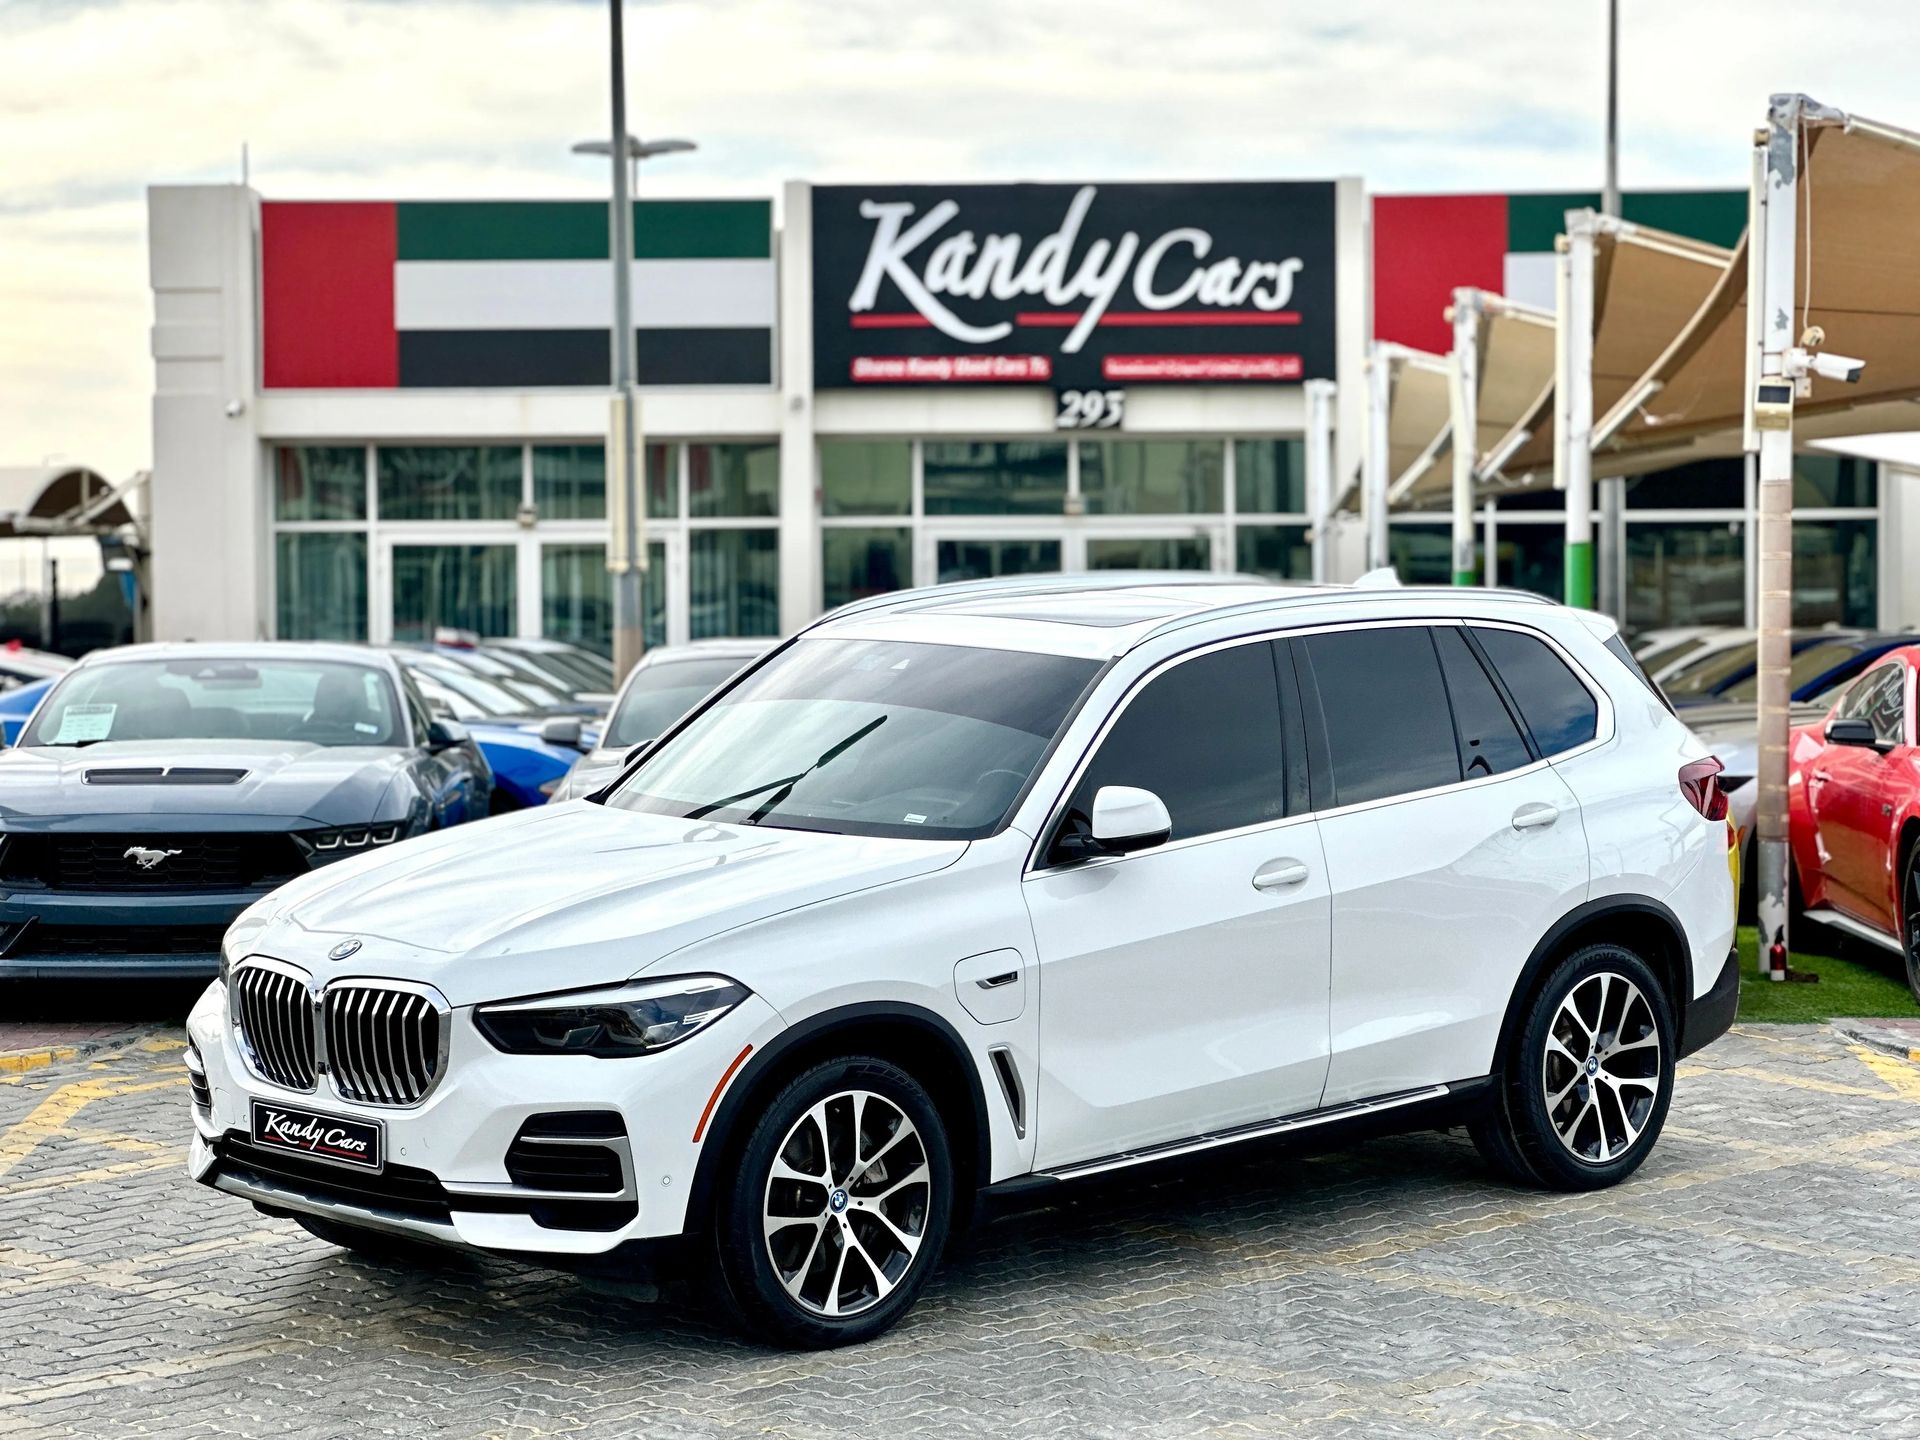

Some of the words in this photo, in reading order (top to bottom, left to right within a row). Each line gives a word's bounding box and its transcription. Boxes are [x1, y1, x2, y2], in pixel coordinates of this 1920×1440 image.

[849, 185, 1139, 353] Kandy
[1133, 228, 1303, 311] Cars
[1055, 389, 1125, 428] 295
[264, 1110, 324, 1150] Kandy
[324, 1128, 367, 1151] Cars
